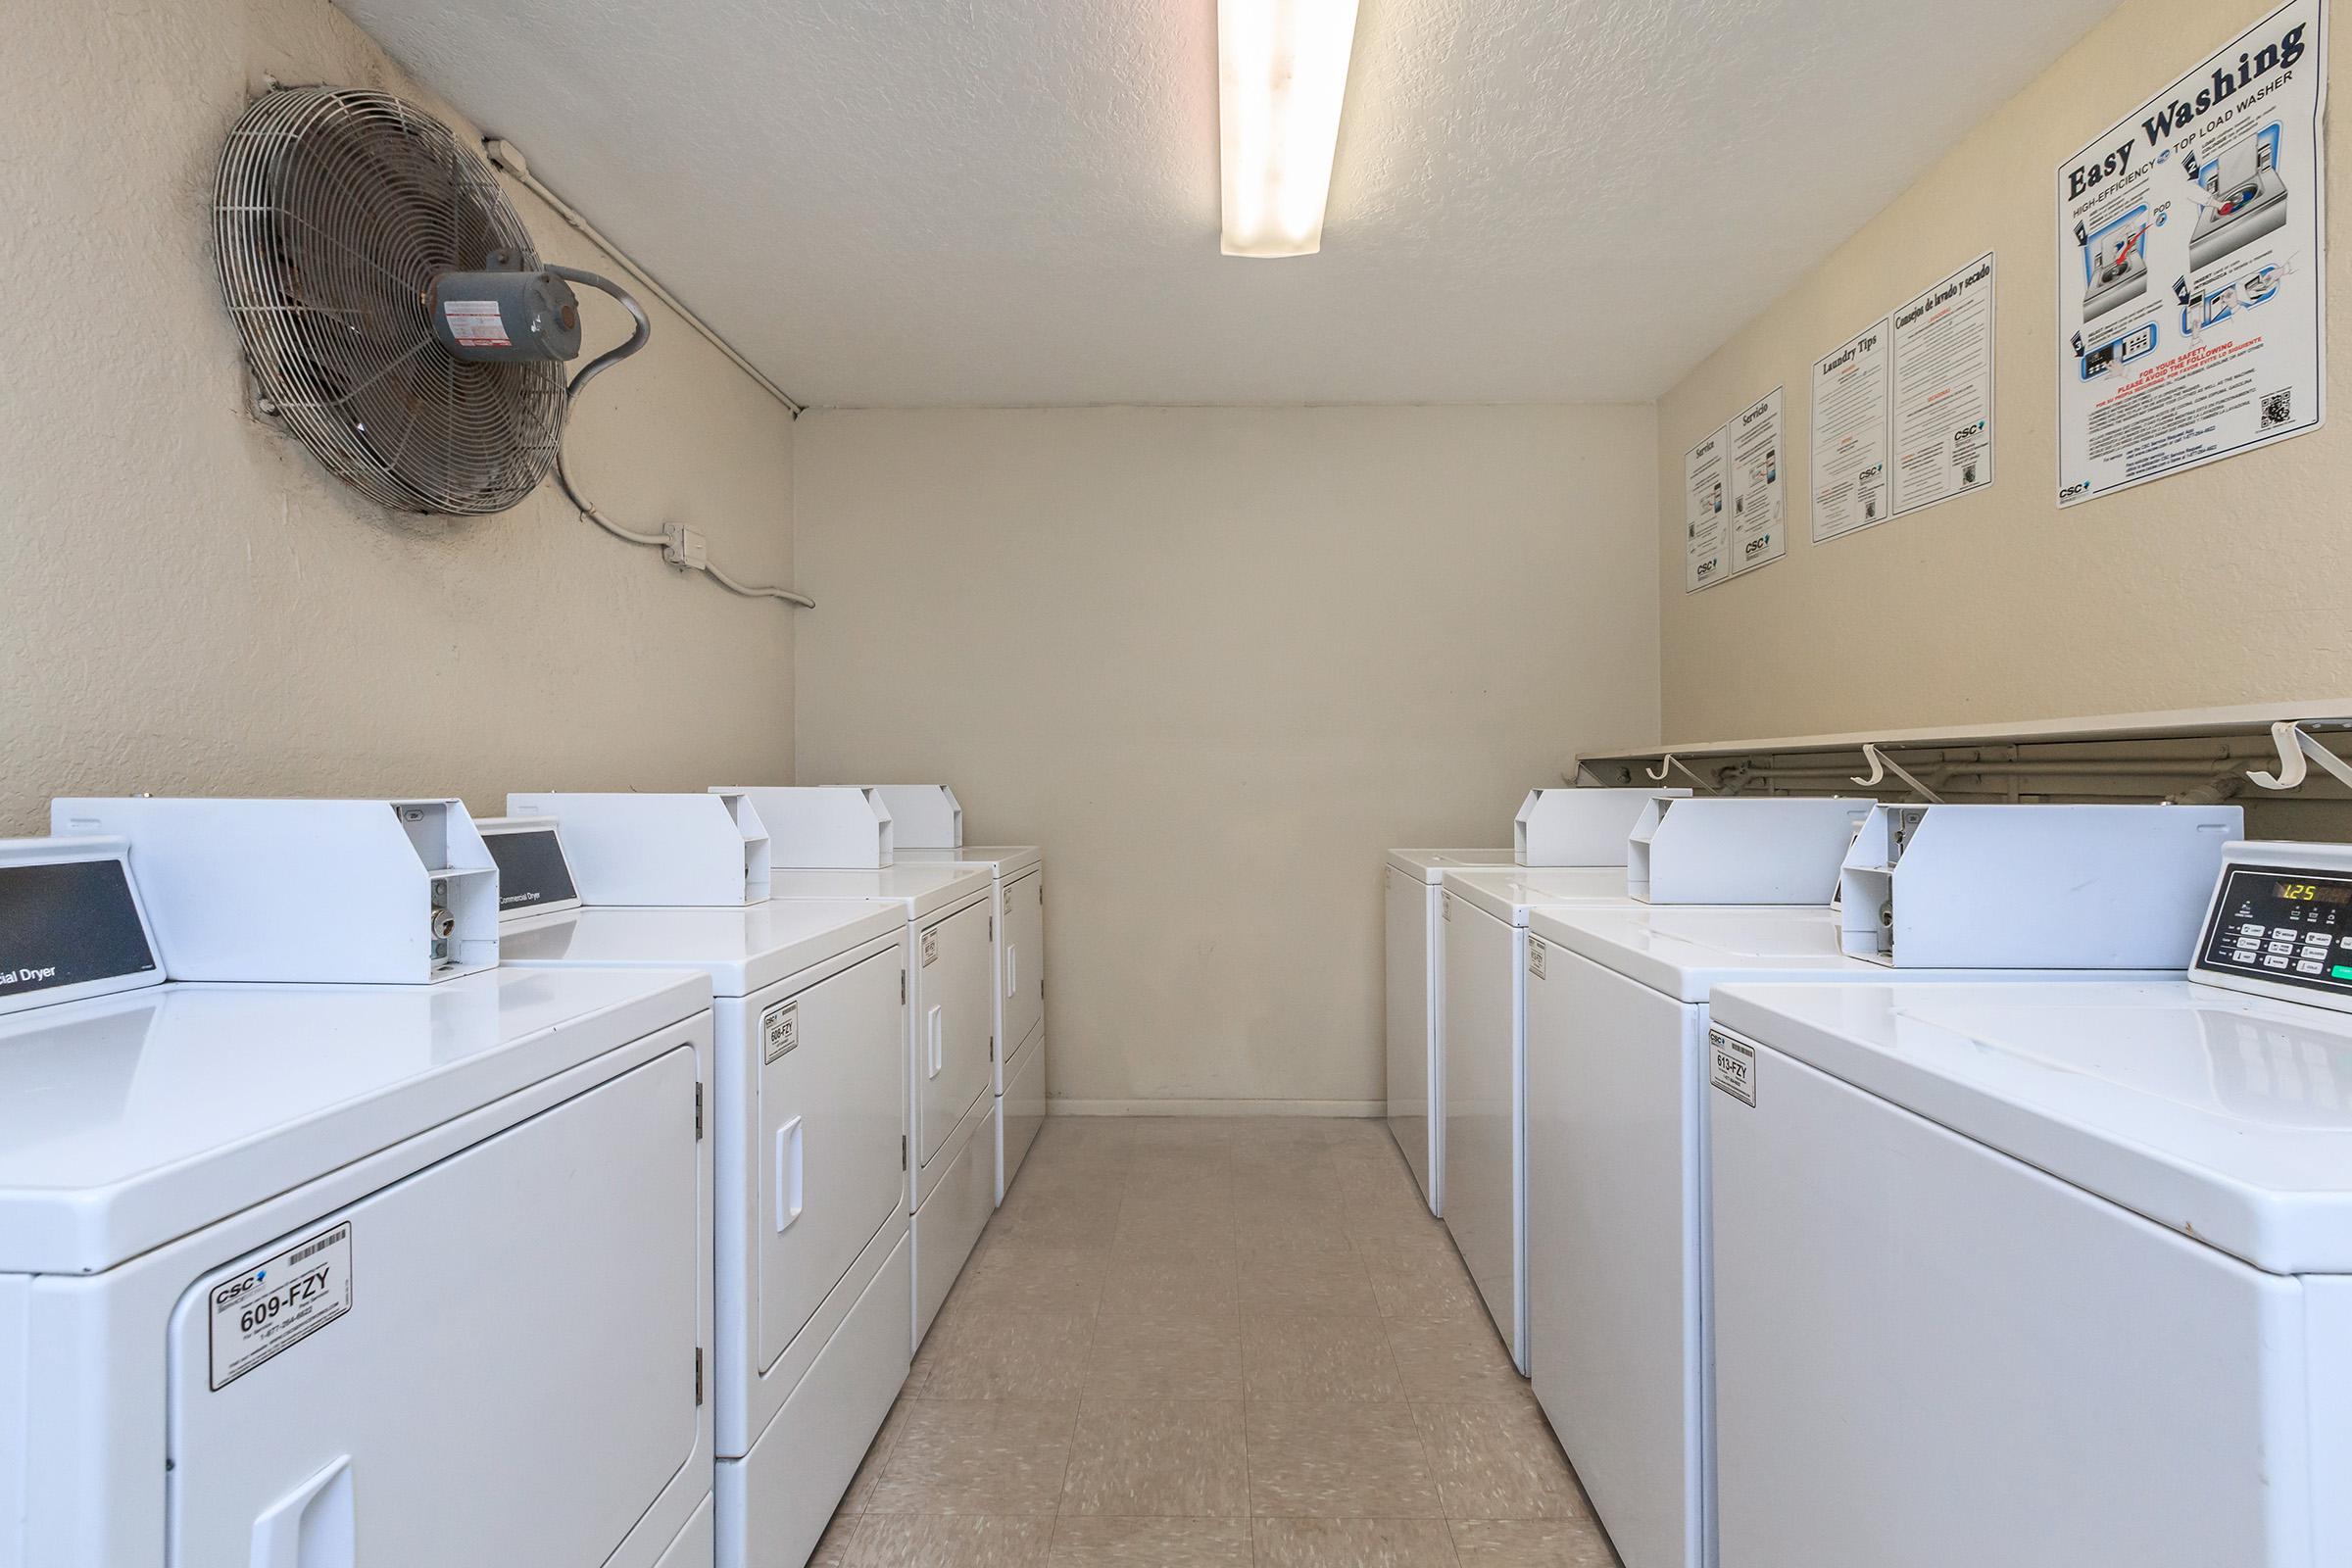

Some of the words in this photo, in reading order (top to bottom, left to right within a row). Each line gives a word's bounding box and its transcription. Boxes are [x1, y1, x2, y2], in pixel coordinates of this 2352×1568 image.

[2068, 138, 2135, 201] Easy
[2141, 22, 2306, 147] Washing
[2173, 133, 2196, 154] TOP
[2199, 110, 2233, 138] LOAD
[2236, 71, 2293, 114] WASHER
[2188, 161, 2197, 173] 2
[2073, 160, 2156, 219] HIGH-EFFICIENCY
[2153, 201, 2172, 217] POD
[2079, 230, 2083, 240] 1
[1895, 306, 1924, 329] Consejos
[1925, 298, 1934, 312] de
[1935, 283, 1958, 307] lavado
[1959, 281, 1964, 296] y
[1965, 264, 1990, 288] secado
[1824, 348, 1856, 375] Laundry
[1858, 335, 1877, 353] Tips
[2075, 340, 2082, 351] 3
[2180, 364, 2199, 373] FAVOR
[2200, 355, 2217, 367] EVITE
[2229, 335, 2263, 355] SIGUIENTE
[2118, 378, 2143, 393] PLEASE
[2145, 369, 2167, 383] AVOID
[2170, 362, 2184, 372] THE
[2186, 340, 2233, 365] FOLLOWING
[2139, 368, 2153, 379] FOR
[2156, 359, 2176, 371] YOUR
[2178, 345, 2207, 363] SAFETY
[1742, 403, 1768, 427] Servicio
[1954, 424, 1977, 441] CSC
[1696, 441, 1714, 459] Service
[1859, 466, 1877, 480] CSC
[2059, 484, 2082, 498] CSC
[1745, 538, 1764, 554] CSC
[1697, 561, 1712, 575] CSC
[20, 966, 56, 981] Dryer
[1717, 1054, 1746, 1078] 613-FZY
[216, 1277, 254, 1304] CSC
[240, 1266, 329, 1332] 609-FZY
